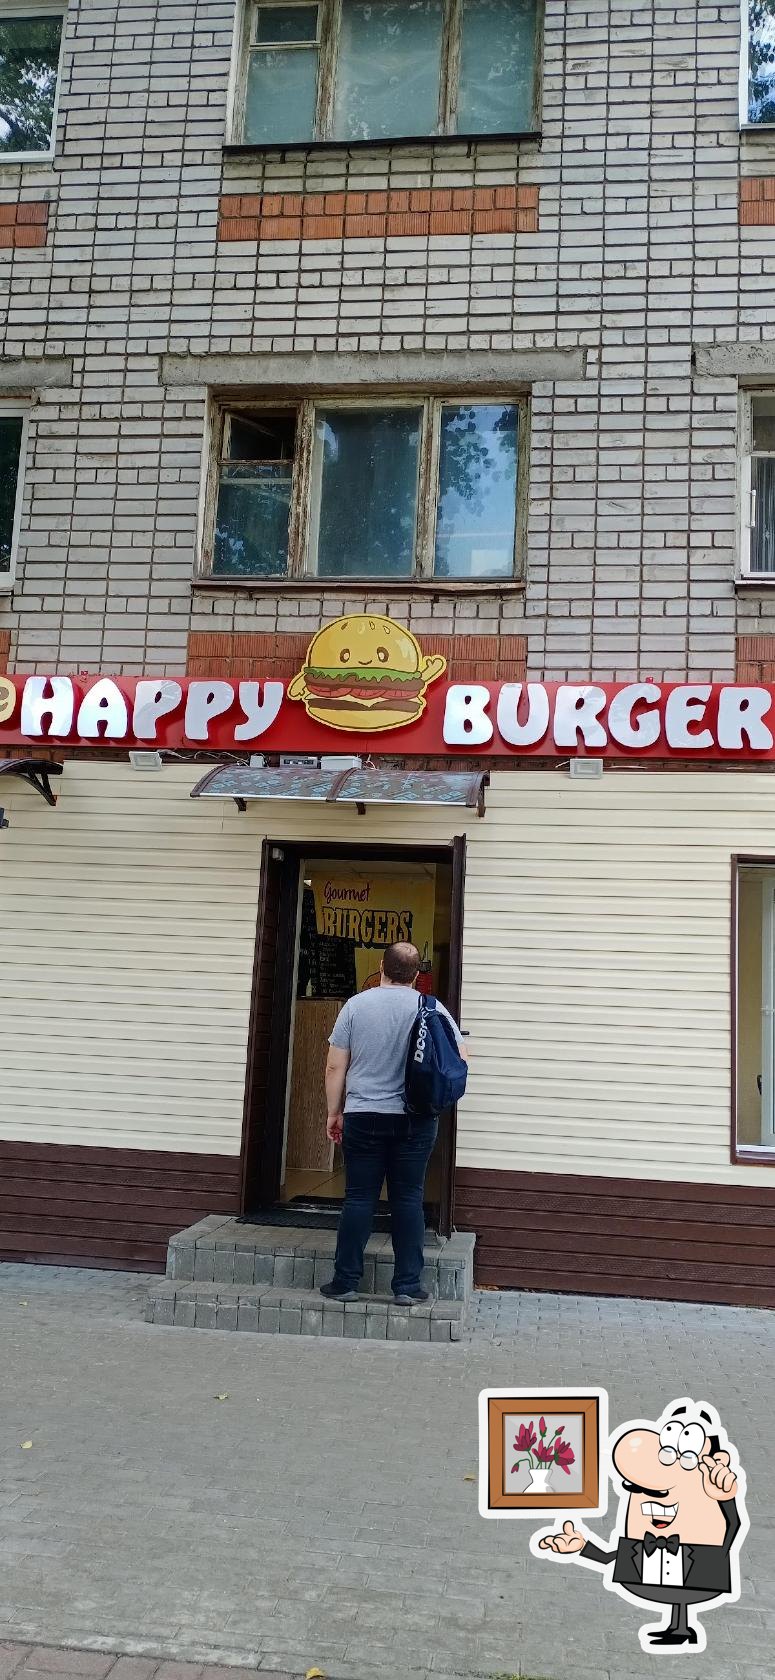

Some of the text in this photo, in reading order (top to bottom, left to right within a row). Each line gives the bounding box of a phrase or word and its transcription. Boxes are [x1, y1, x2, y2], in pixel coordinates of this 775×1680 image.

[20, 676, 772, 750] HAPPY BURGER
[324, 881, 371, 903] Gourmet
[319, 906, 413, 947] BURGERS
